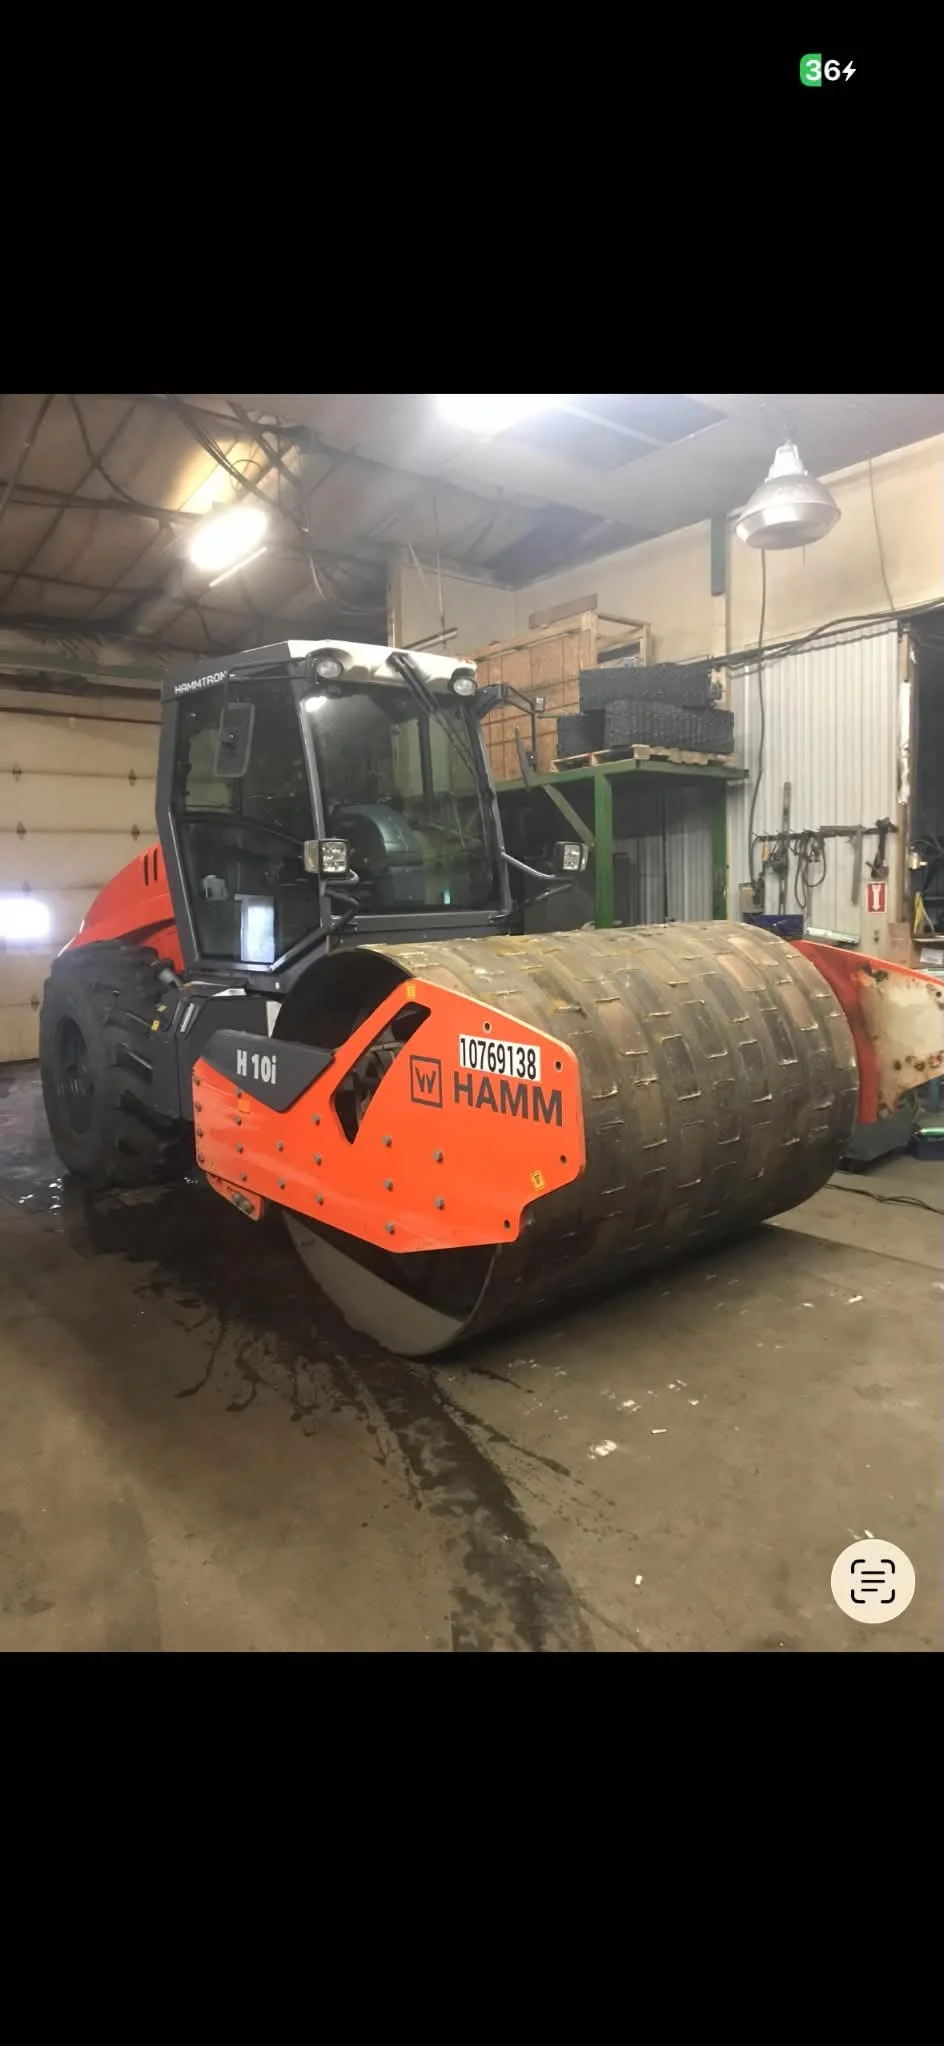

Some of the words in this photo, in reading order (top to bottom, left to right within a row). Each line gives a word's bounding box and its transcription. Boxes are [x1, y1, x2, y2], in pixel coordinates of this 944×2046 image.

[236, 1048, 248, 1077] H
[251, 1053, 277, 1085] 10i
[460, 1037, 537, 1080] 10769138
[453, 1070, 563, 1128] HAMM
